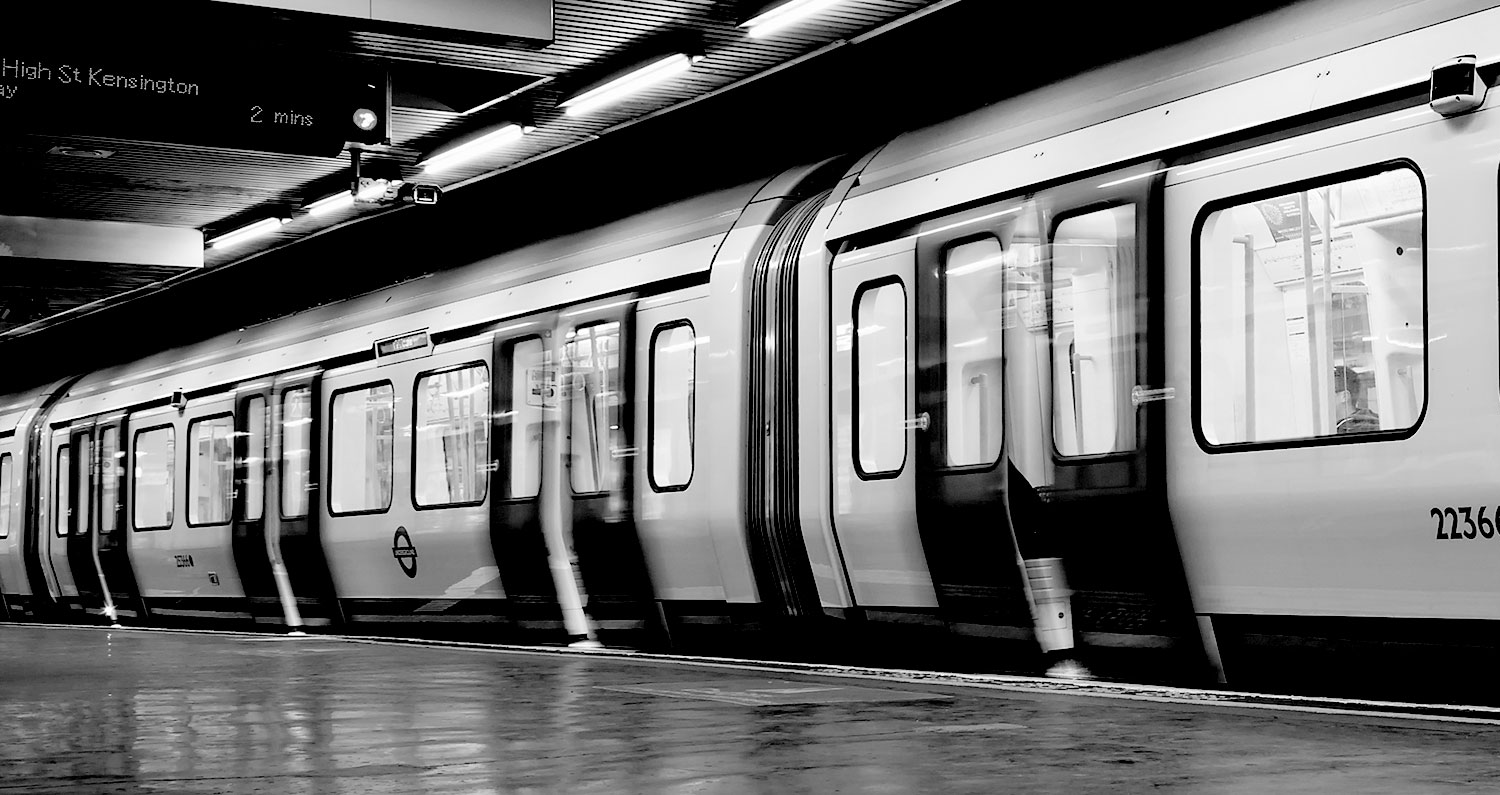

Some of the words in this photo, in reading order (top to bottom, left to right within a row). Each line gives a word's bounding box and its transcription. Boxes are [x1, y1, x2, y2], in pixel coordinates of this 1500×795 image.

[2, 57, 51, 80] High
[58, 65, 82, 84] St
[88, 67, 199, 96] Kensington
[250, 105, 263, 123] 2
[274, 110, 314, 127] mins
